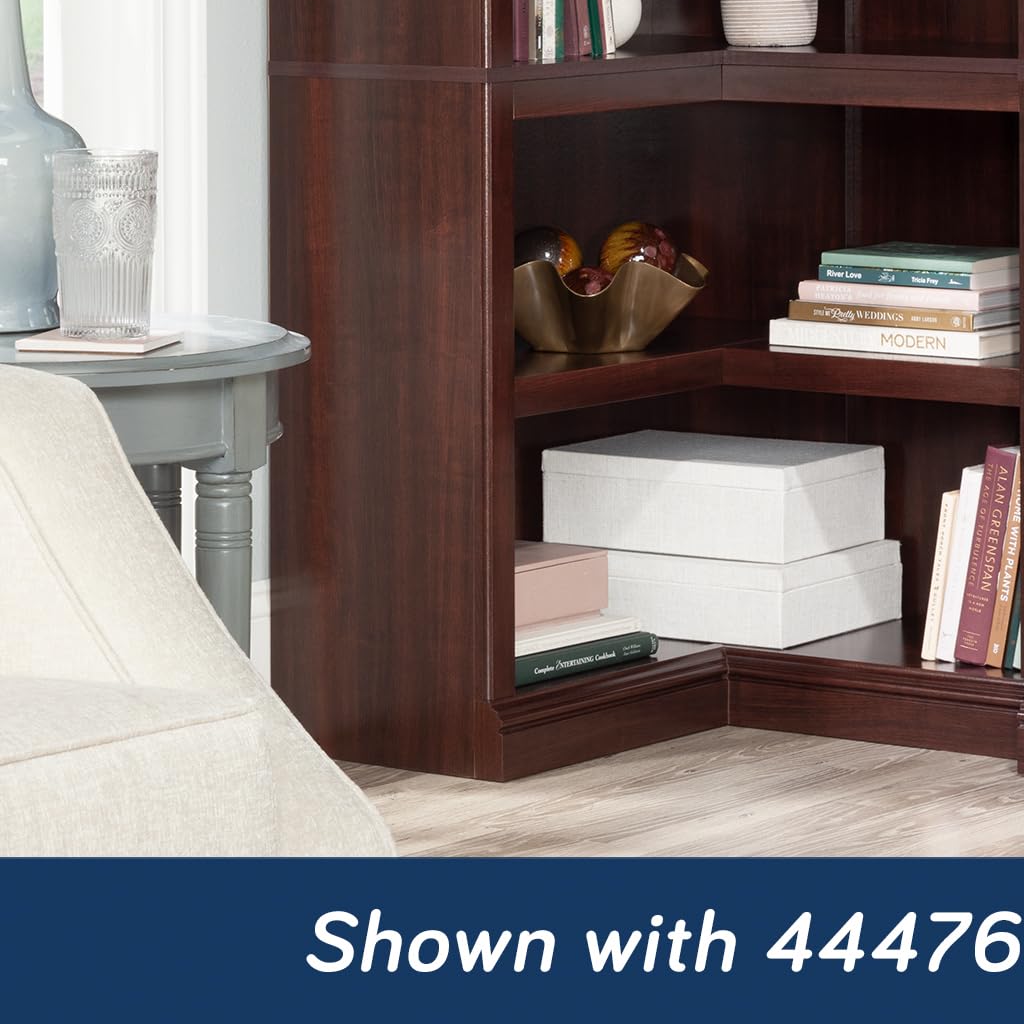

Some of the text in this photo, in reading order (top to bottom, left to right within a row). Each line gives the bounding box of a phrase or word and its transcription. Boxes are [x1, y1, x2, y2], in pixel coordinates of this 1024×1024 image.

[826, 269, 862, 280] River Love
[911, 275, 939, 286] Tricia Frey
[831, 307, 855, 322] Pretty
[856, 310, 904, 321] WEDDINGS
[880, 333, 946, 351] MODERN
[982, 484, 991, 504] AGE
[980, 507, 987, 521] OF
[981, 464, 1009, 592] ALAN GREENSPAN
[1007, 526, 1020, 558] WITH
[968, 524, 984, 586] TURBULENCE
[999, 558, 1014, 602] PLANTS
[534, 664, 555, 675] Complete
[555, 655, 594, 671] ENTERTAINING
[595, 650, 616, 661] Cookbook
